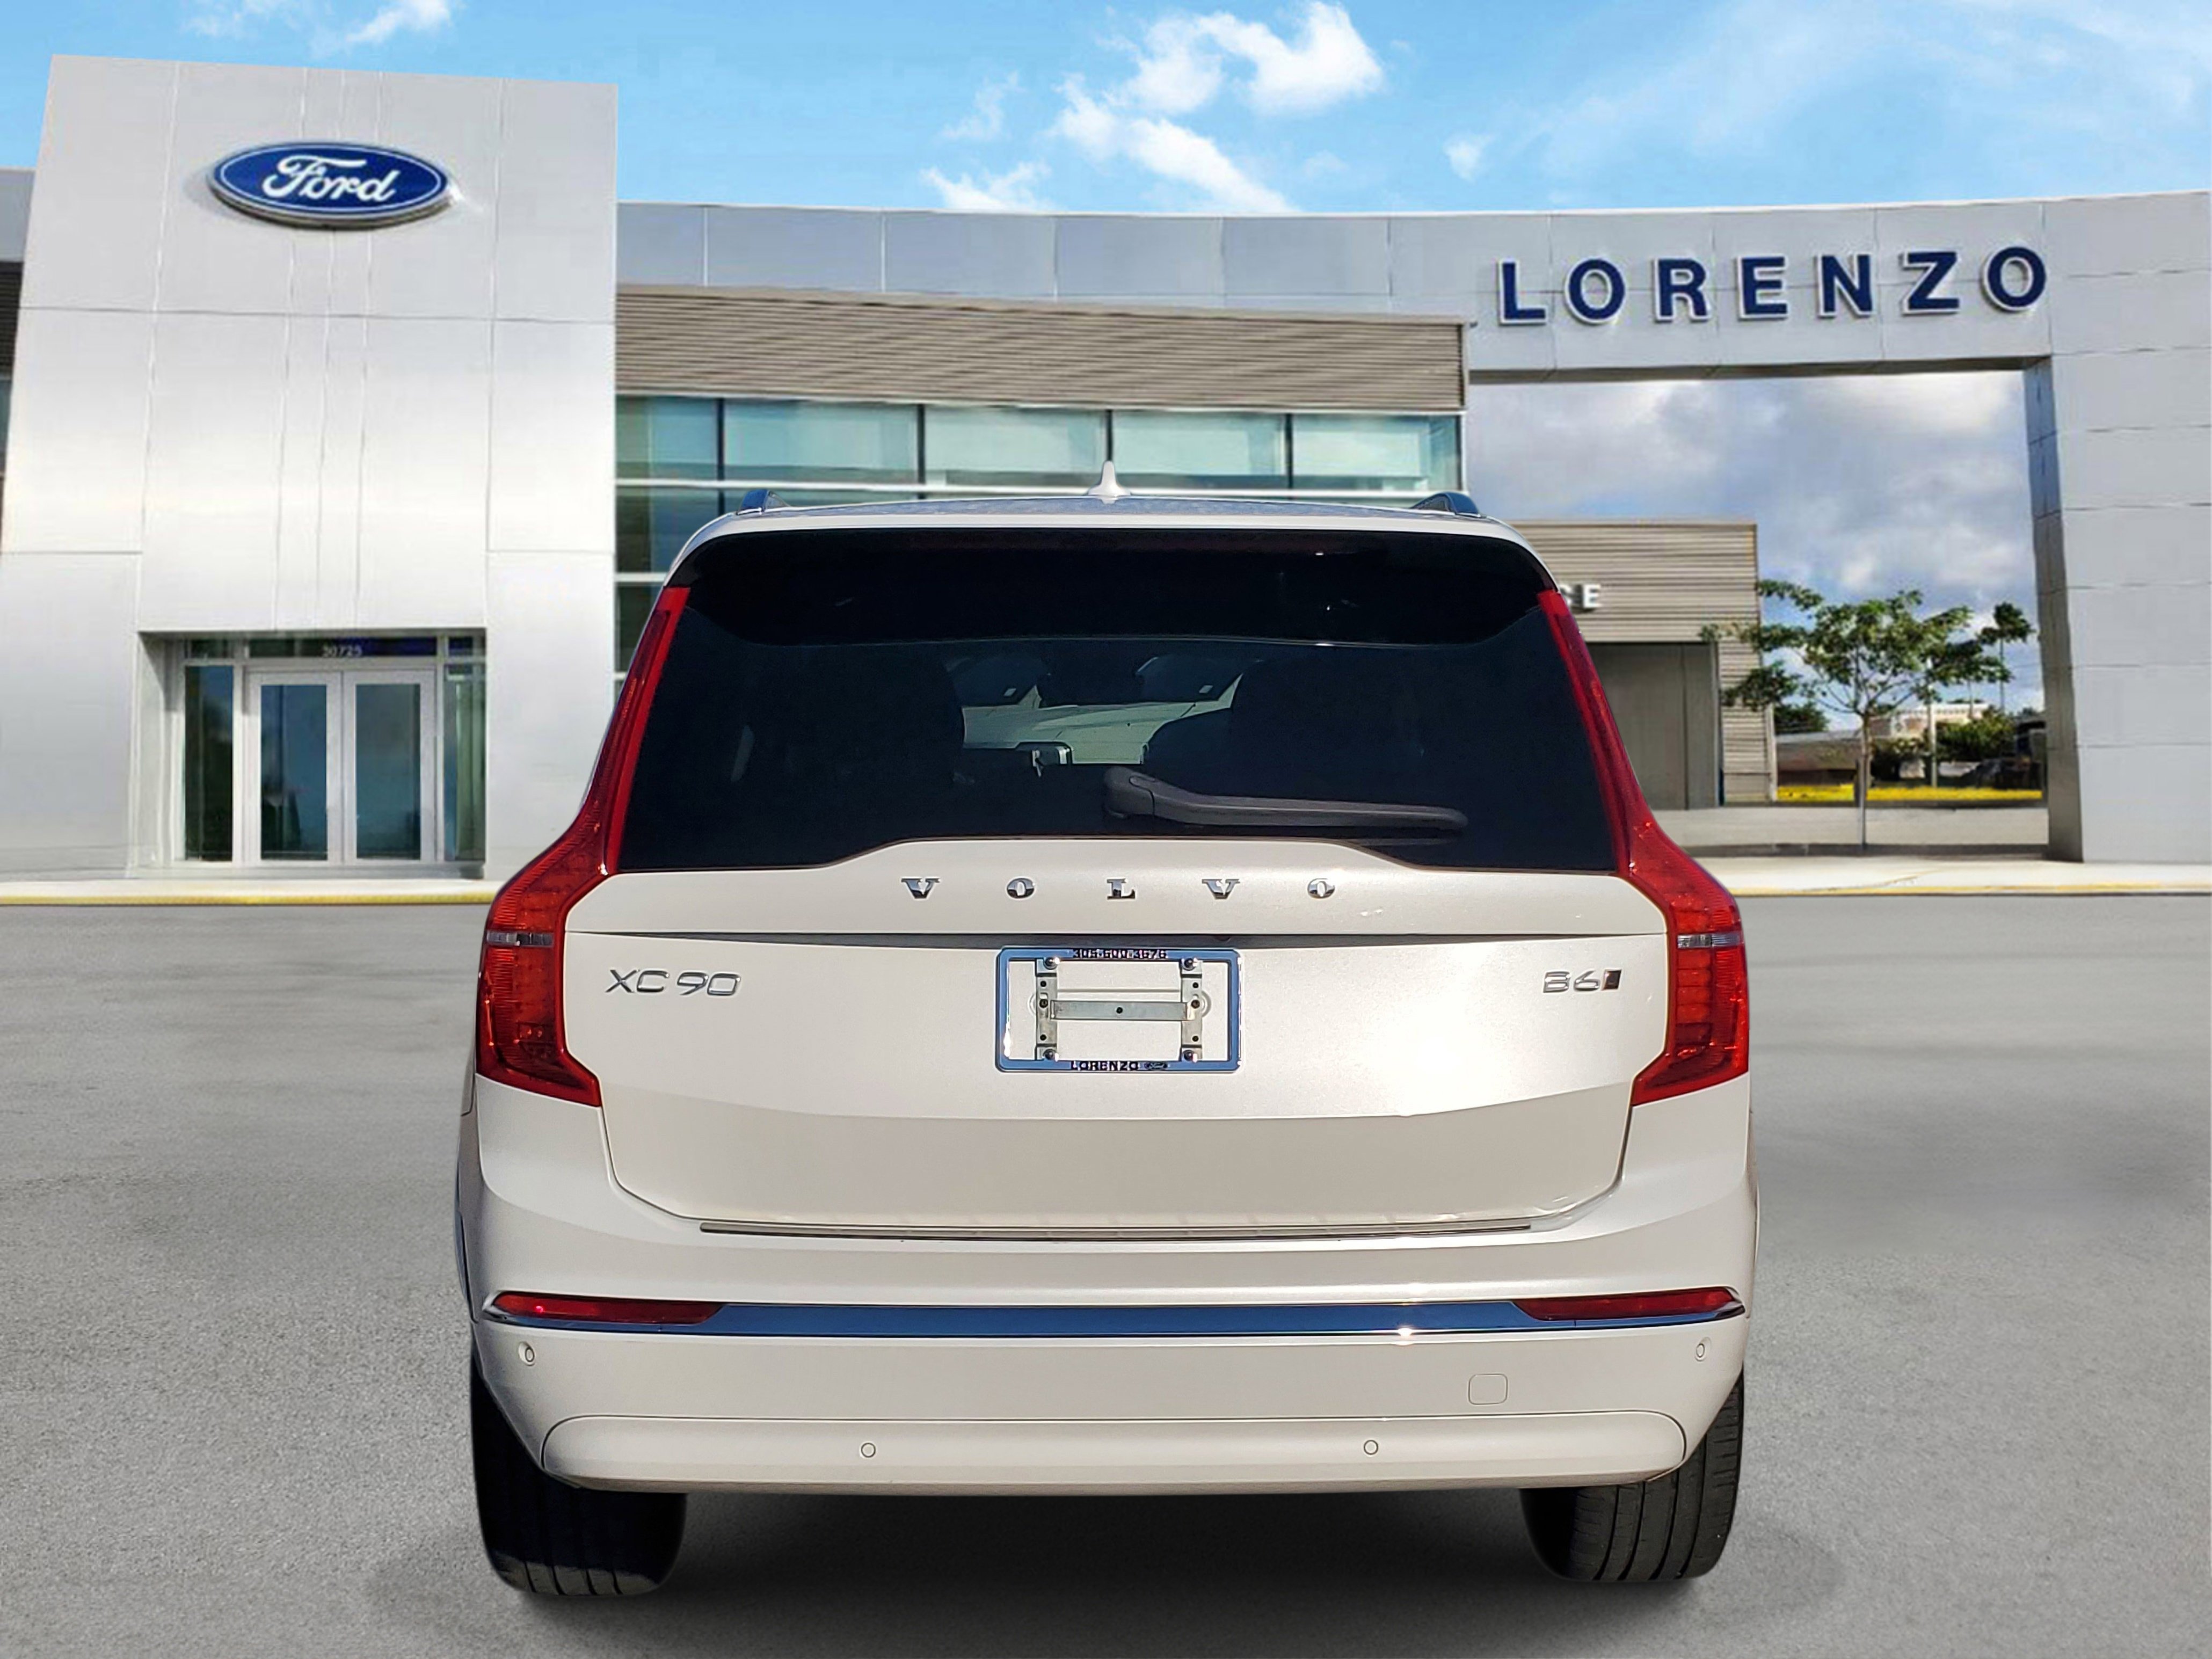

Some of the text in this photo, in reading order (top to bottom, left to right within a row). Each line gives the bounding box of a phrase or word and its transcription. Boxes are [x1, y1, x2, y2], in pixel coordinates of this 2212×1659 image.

[263, 154, 401, 202] Ford
[1498, 246, 2048, 325] LORENZO
[901, 877, 1336, 900] VOLVO
[1542, 970, 1601, 993] B6
[1071, 1061, 1139, 1071] LORENZO
